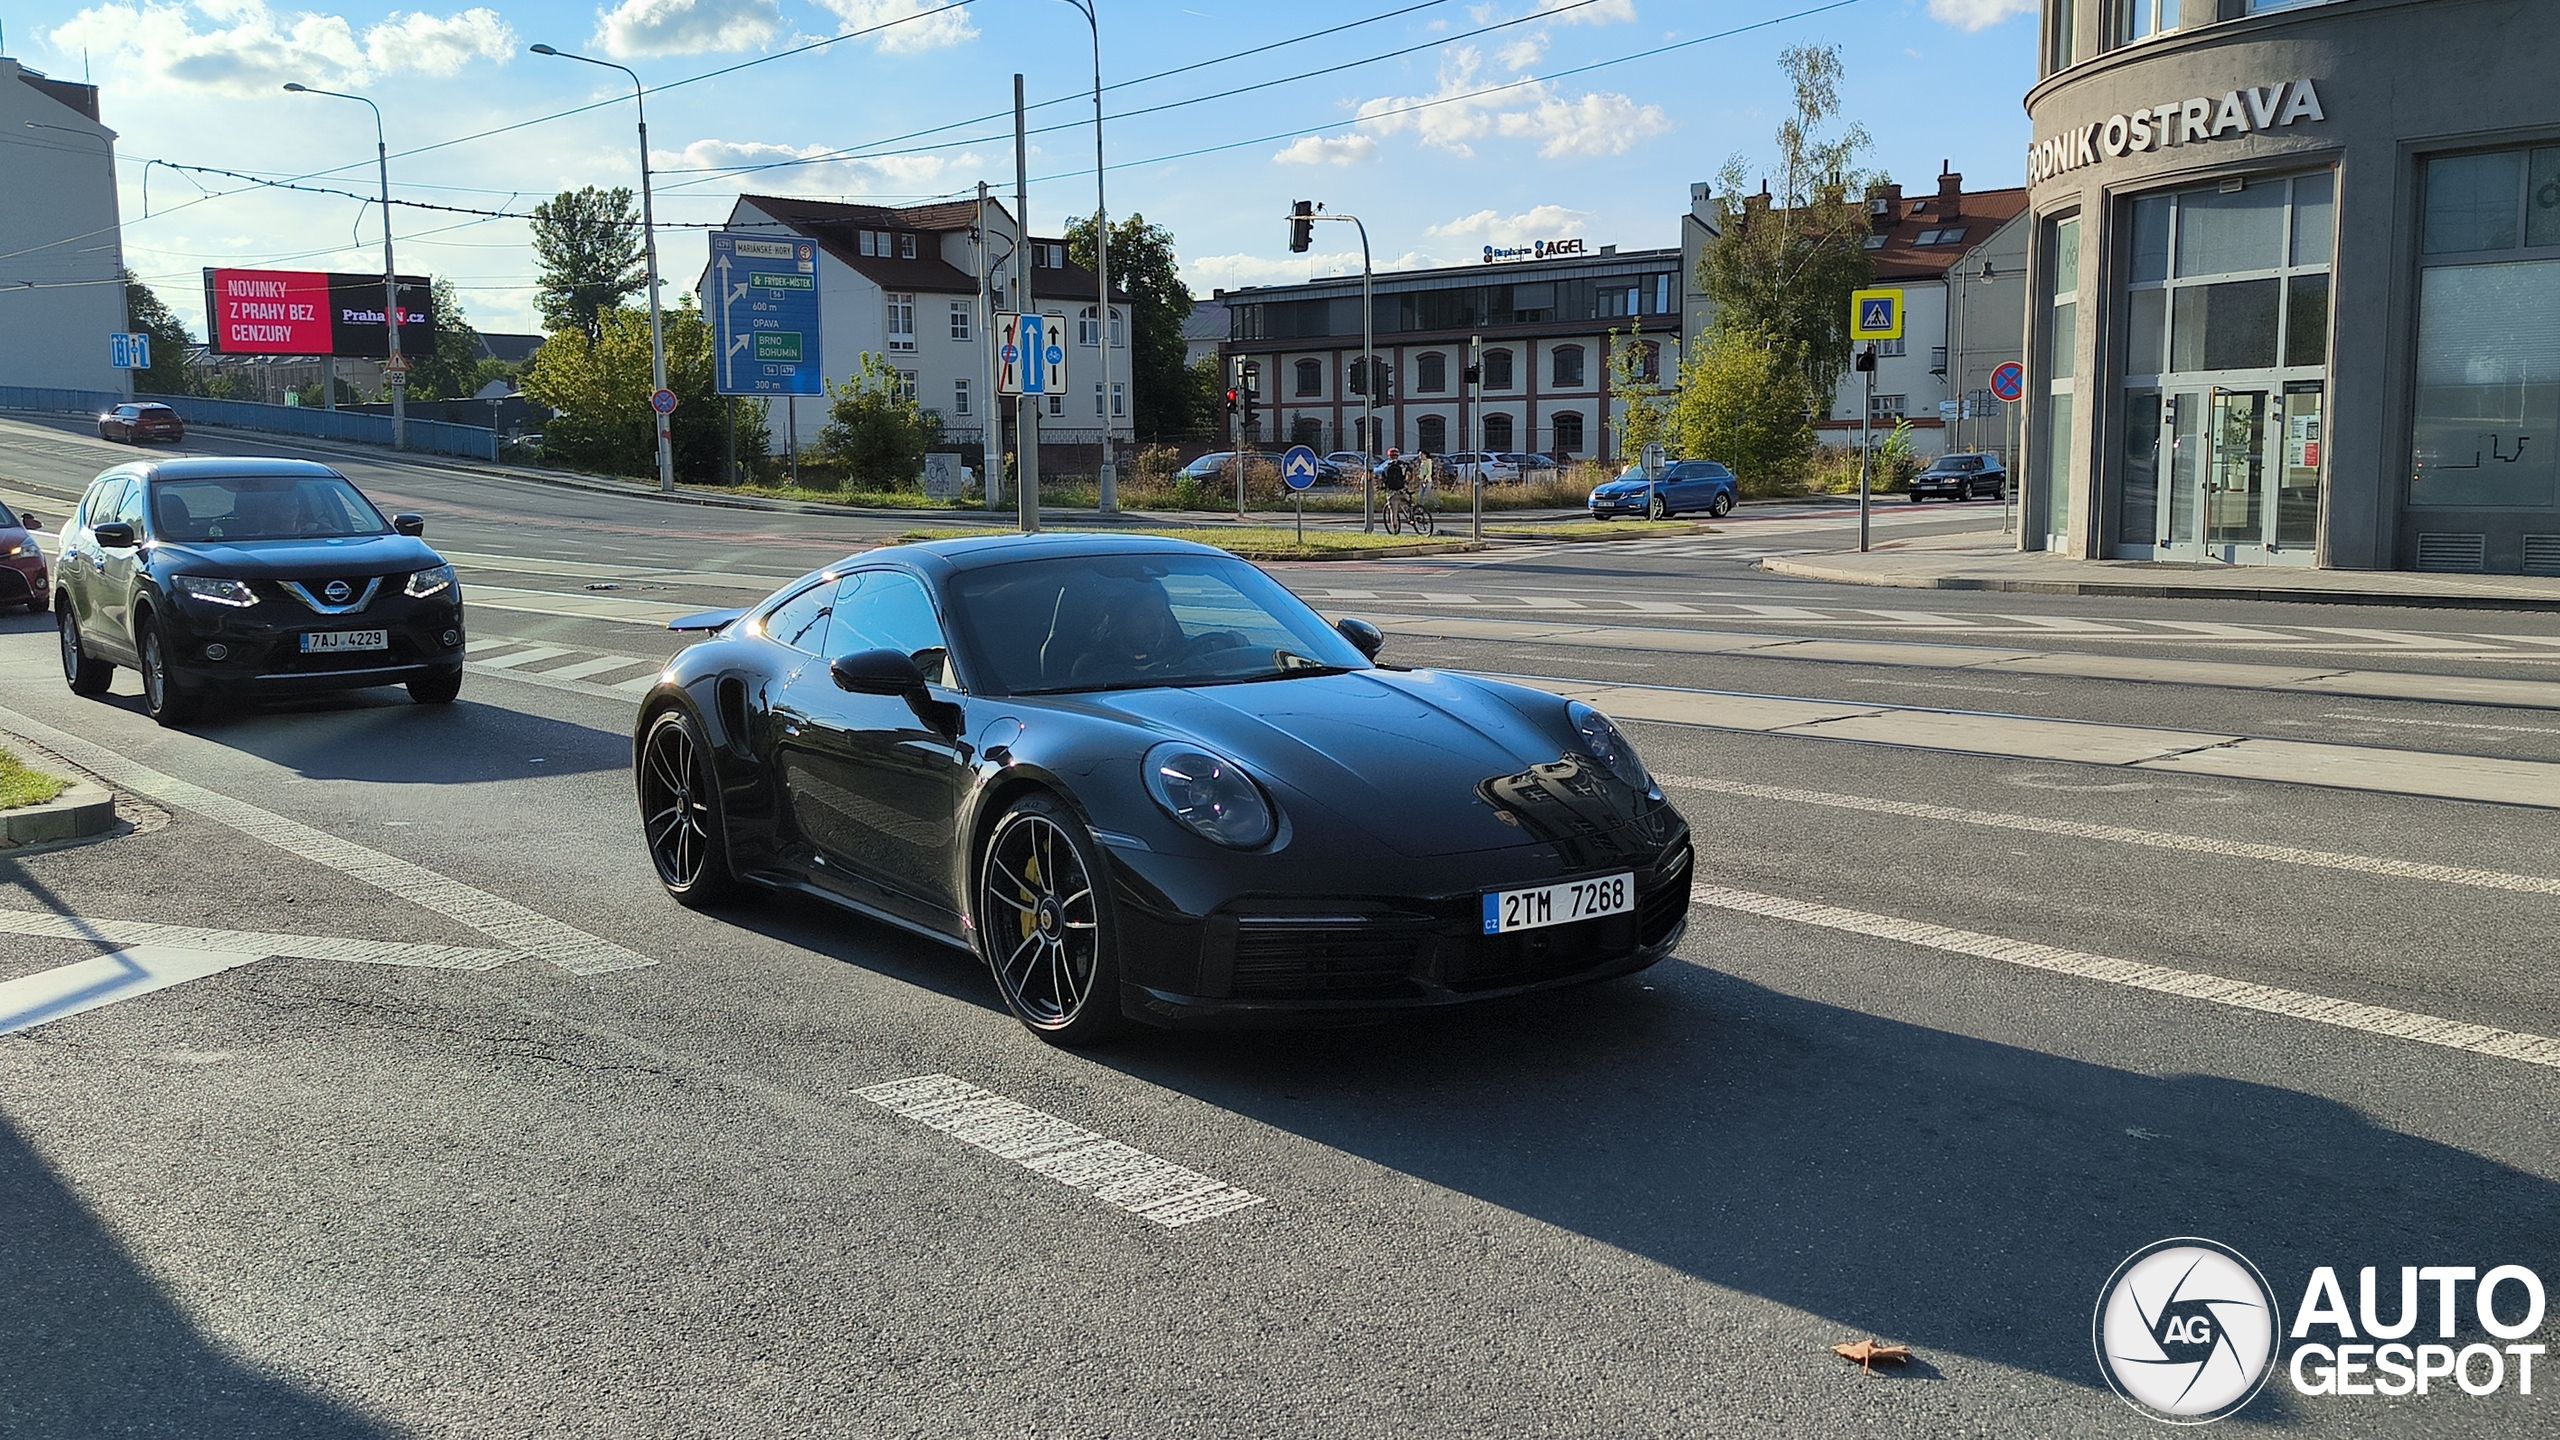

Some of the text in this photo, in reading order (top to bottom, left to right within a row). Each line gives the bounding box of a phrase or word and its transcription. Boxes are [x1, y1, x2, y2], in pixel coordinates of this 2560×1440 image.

[2029, 78, 2325, 189] PODNIK OSTRAVA
[737, 243, 791, 255] MARIÁNSKÉ HORY
[1544, 239, 1588, 256] AGEL
[764, 275, 811, 288] FRÝDEK-MÍSTEK
[228, 279, 287, 298] NOVINKY
[230, 302, 315, 321] Z PRAHY BEZ
[752, 301, 767, 311] 600
[753, 318, 780, 328] OPAVA
[232, 324, 292, 342] CENZURY
[759, 336, 782, 345] BRNO
[759, 346, 797, 357] BOHUMÍN
[755, 380, 770, 389] 300
[312, 632, 382, 648] 7AJ 4229
[1505, 878, 1625, 928] 2TM 7268
[1485, 919, 1498, 930] CZ
